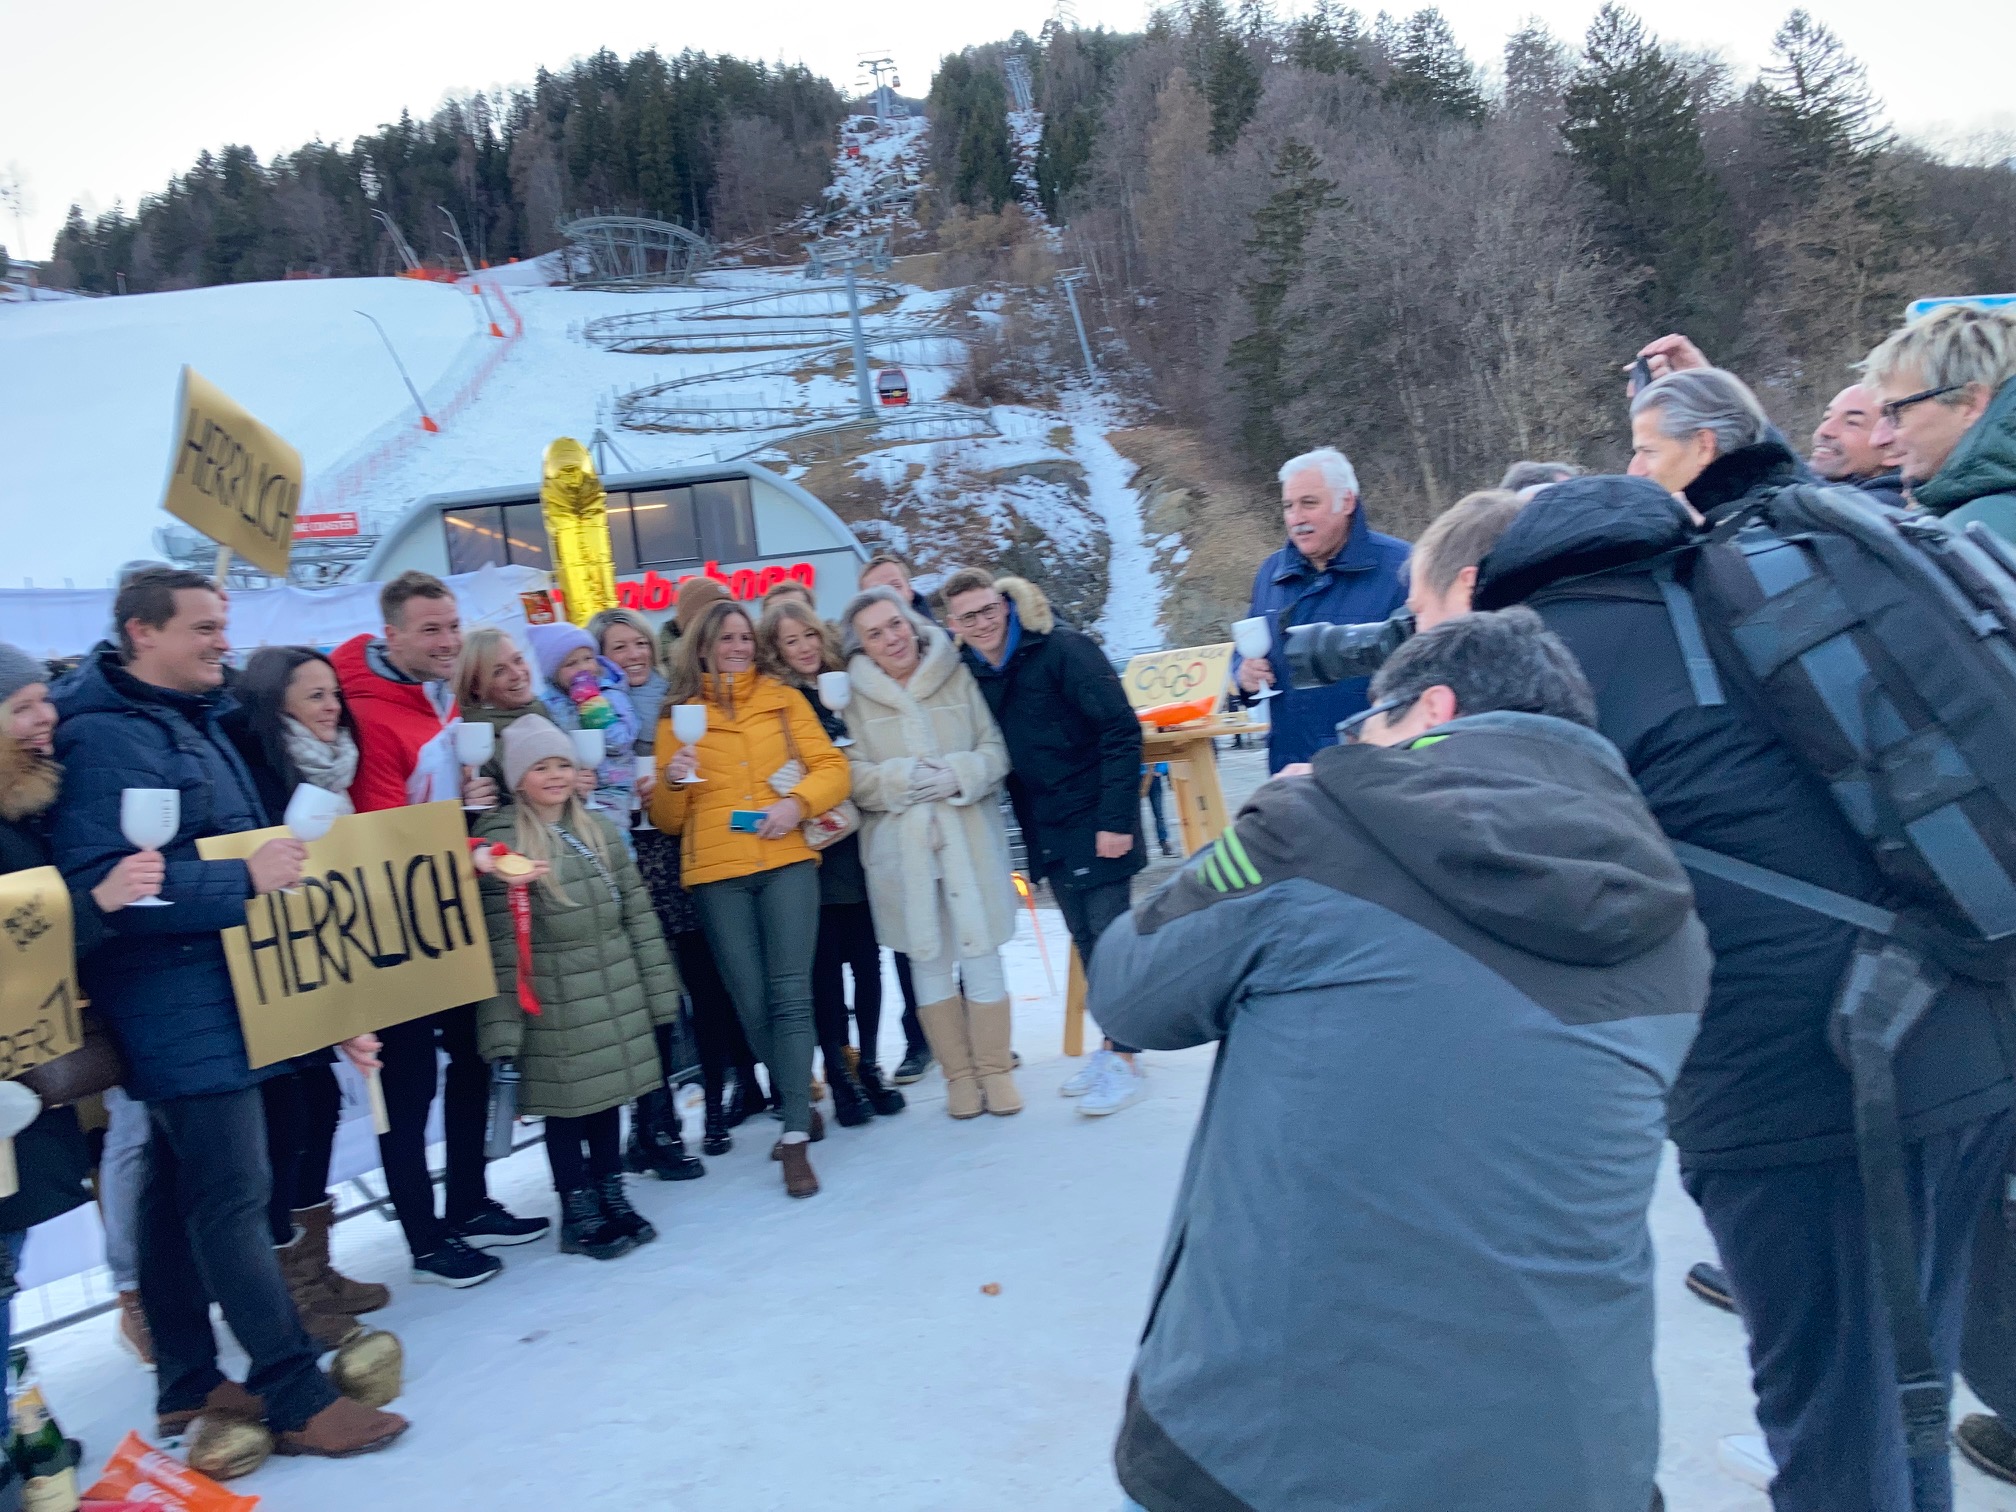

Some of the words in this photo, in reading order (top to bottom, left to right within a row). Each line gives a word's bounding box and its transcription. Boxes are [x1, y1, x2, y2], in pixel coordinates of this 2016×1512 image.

[176, 407, 299, 550] HERRLICH
[246, 850, 473, 1005] HERRLICH
[38, 977, 77, 1045] 1
